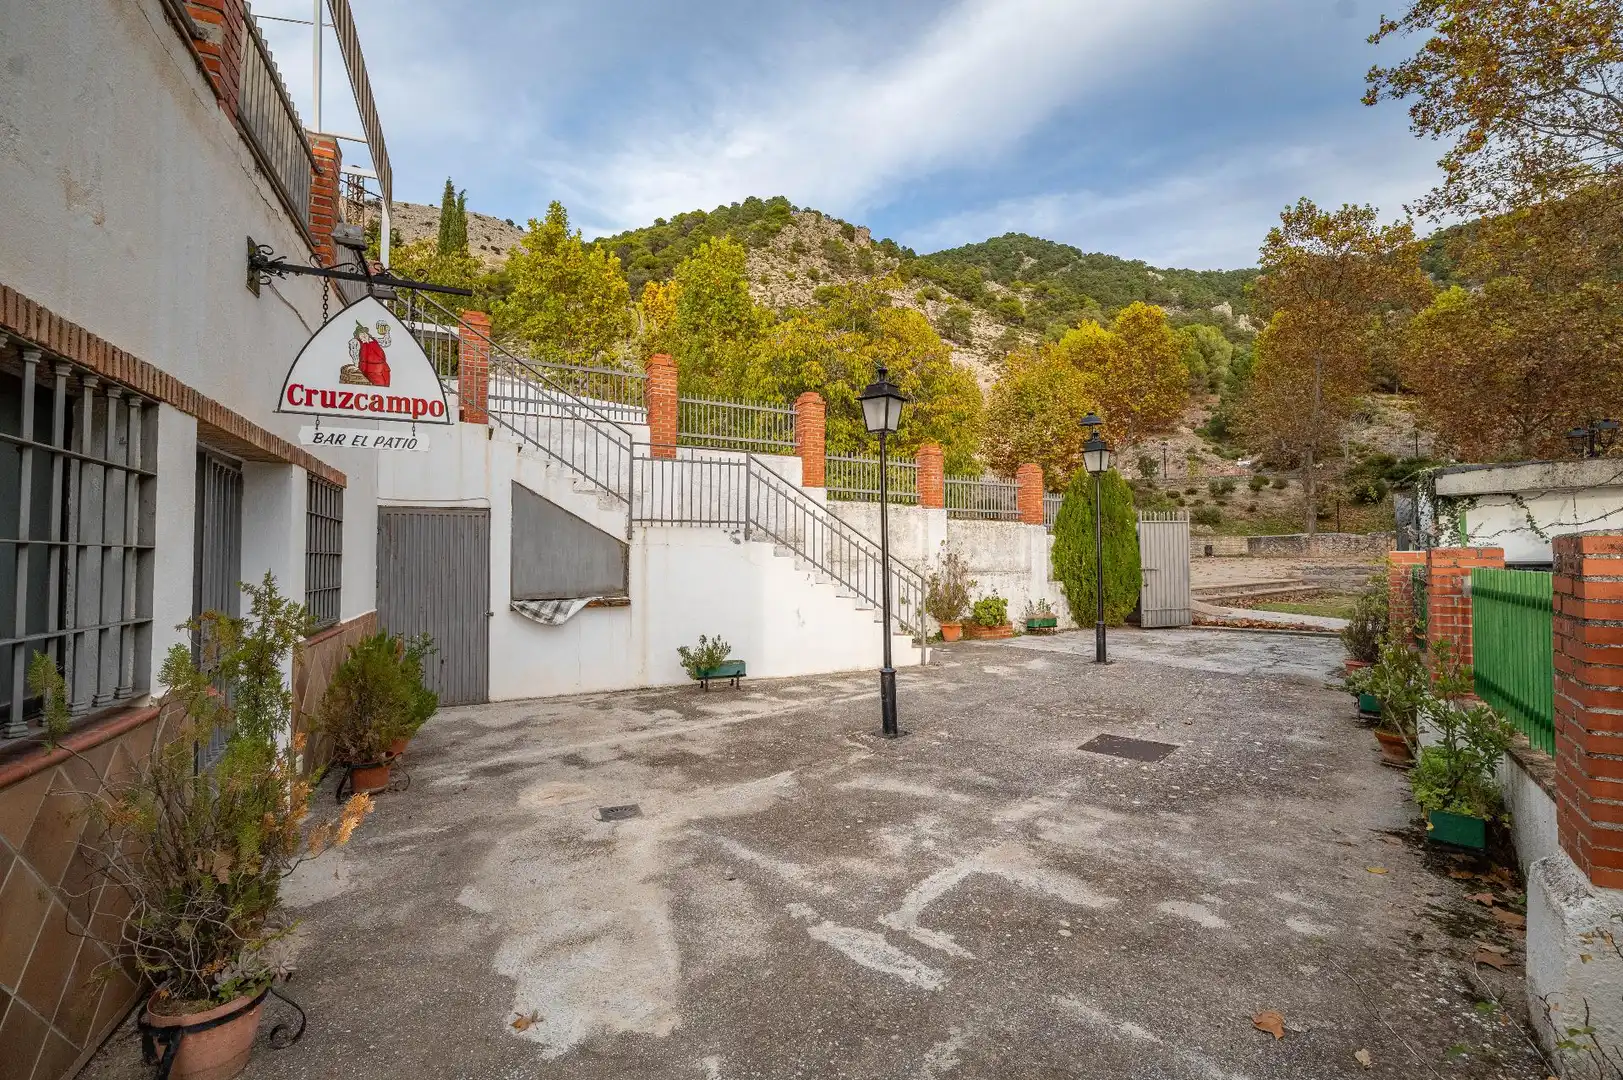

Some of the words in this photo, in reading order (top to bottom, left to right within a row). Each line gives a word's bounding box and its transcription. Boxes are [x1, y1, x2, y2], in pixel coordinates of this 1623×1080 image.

[287, 383, 445, 419] Cruzcampo
[312, 432, 347, 445] BAR
[351, 434, 369, 447] EL
[373, 435, 418, 450] PATIO
